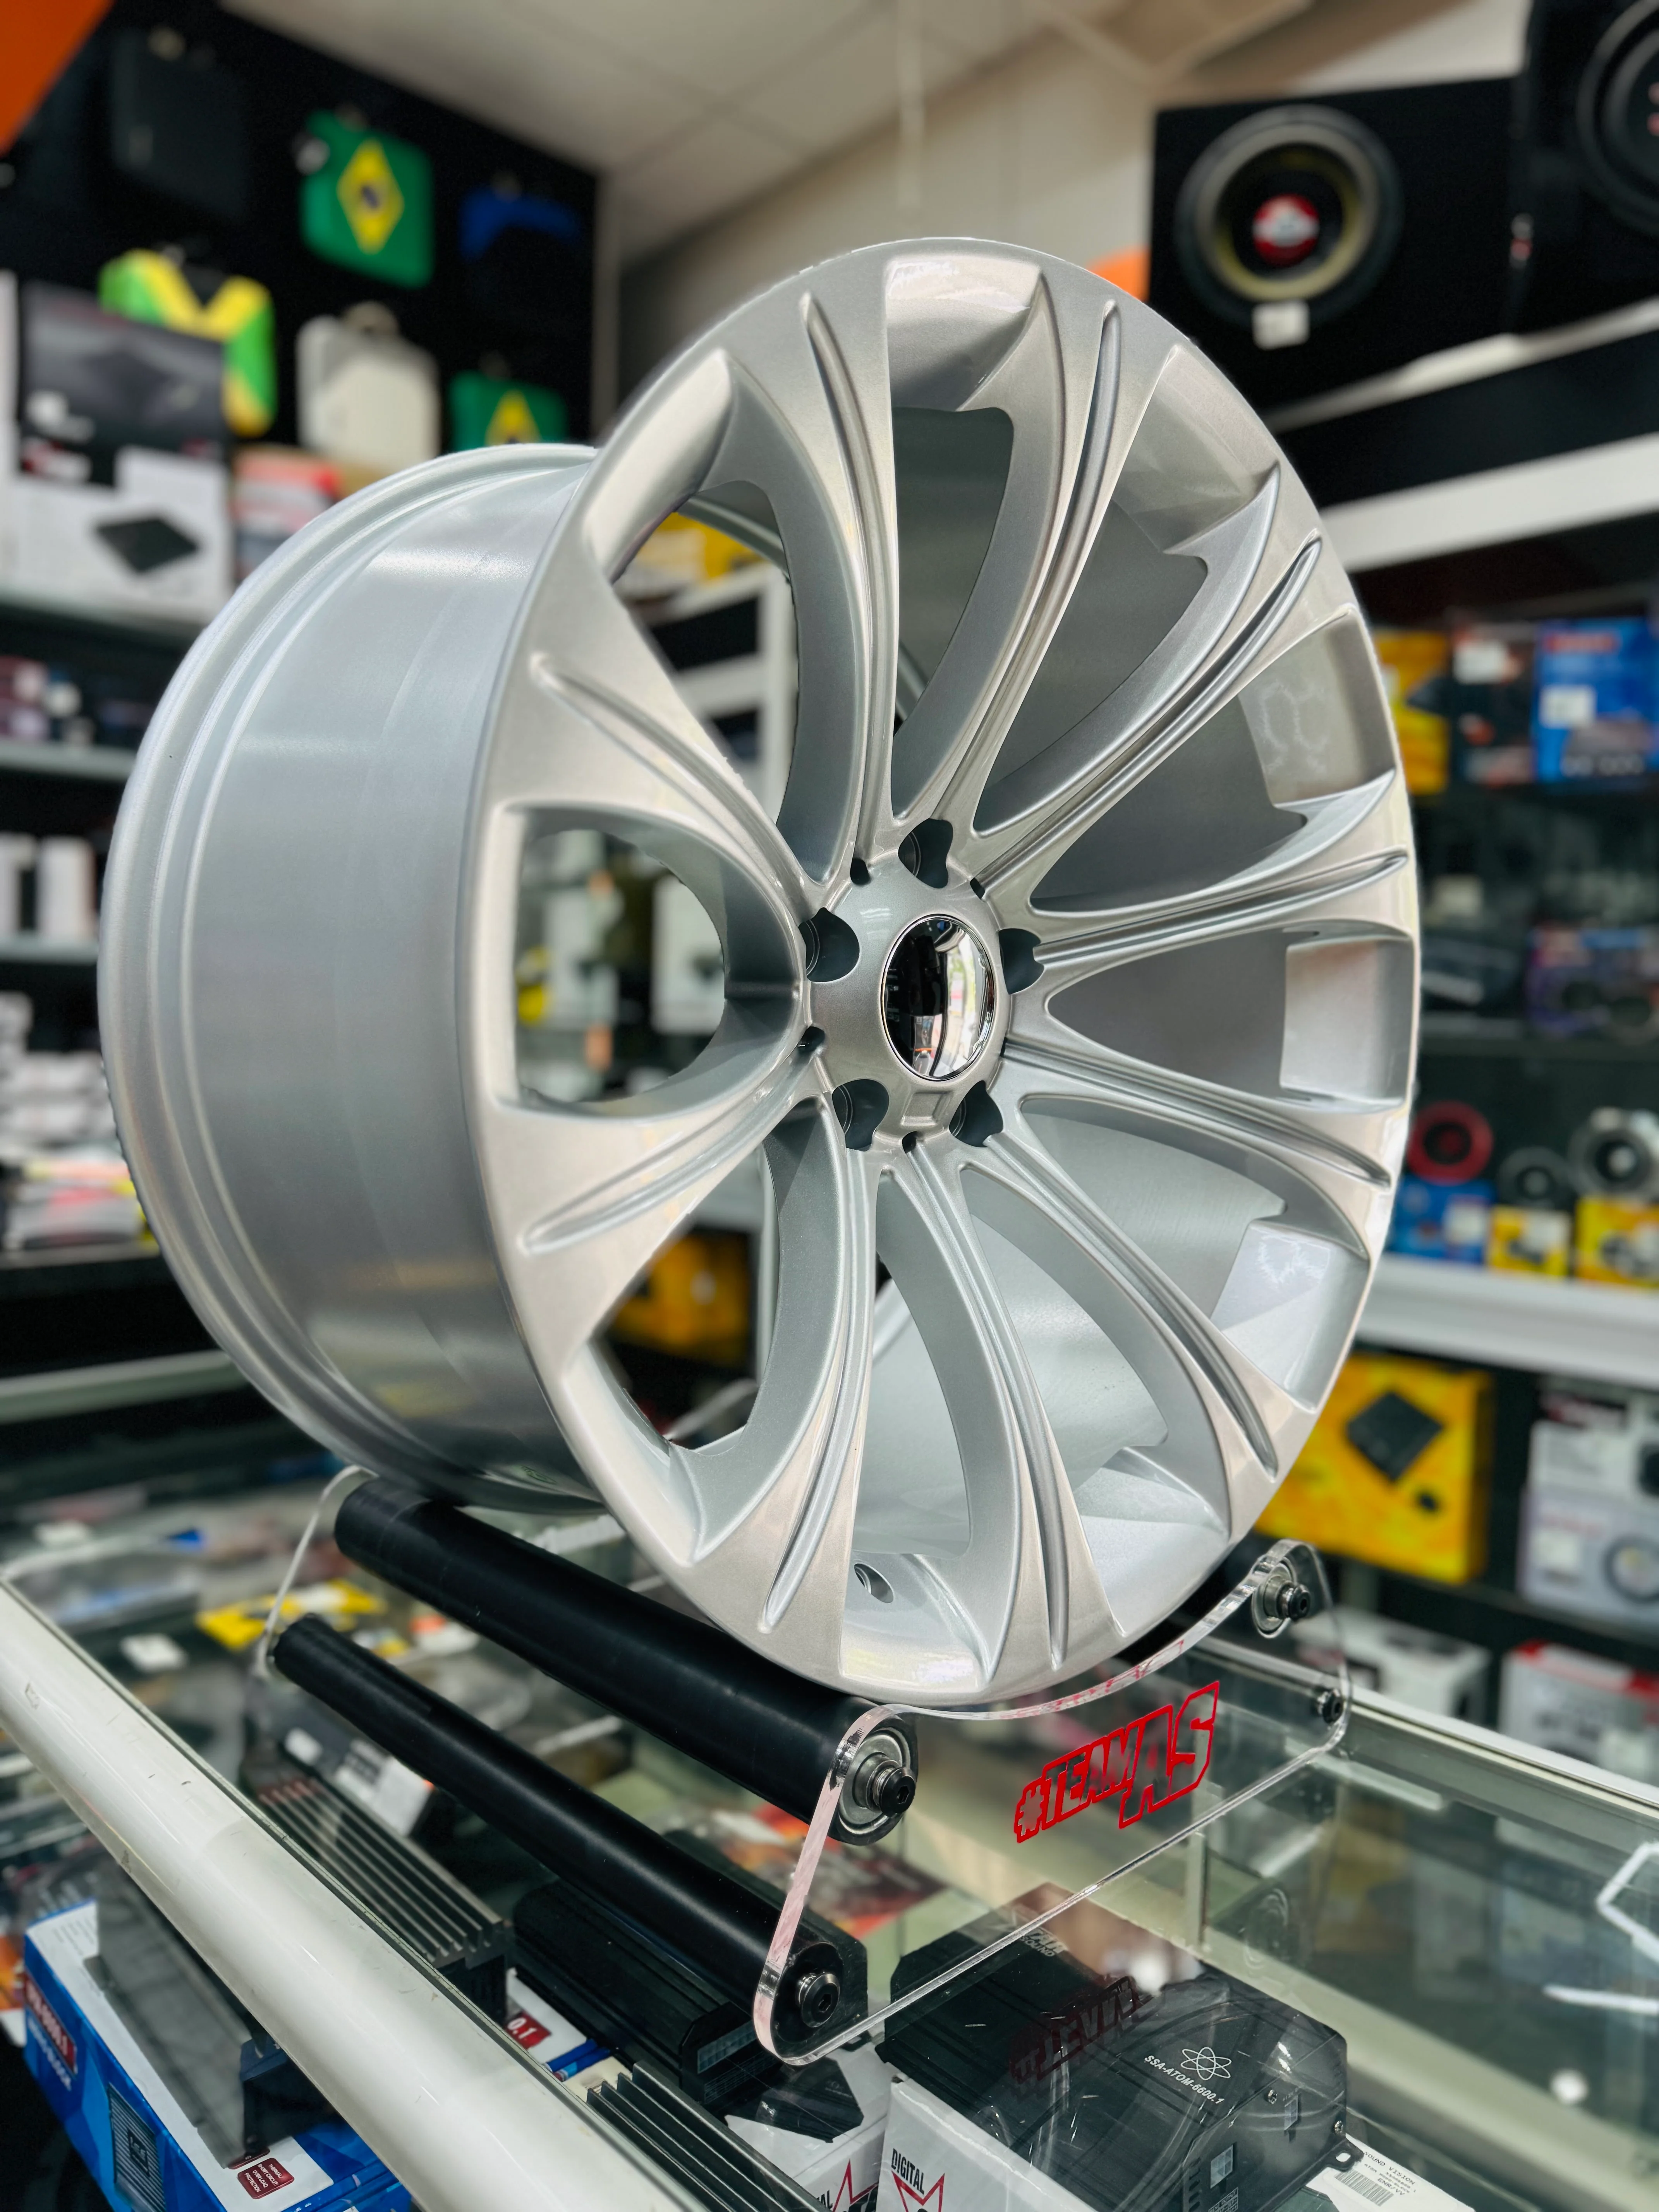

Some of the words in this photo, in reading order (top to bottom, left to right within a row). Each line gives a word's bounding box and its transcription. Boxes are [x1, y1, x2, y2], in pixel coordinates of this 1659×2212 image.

[1144, 2055, 1225, 2104] SSA-ATOM-6600.1
[891, 2148, 925, 2195] DIGITAL
[1389, 2166, 1415, 2185] VISION
